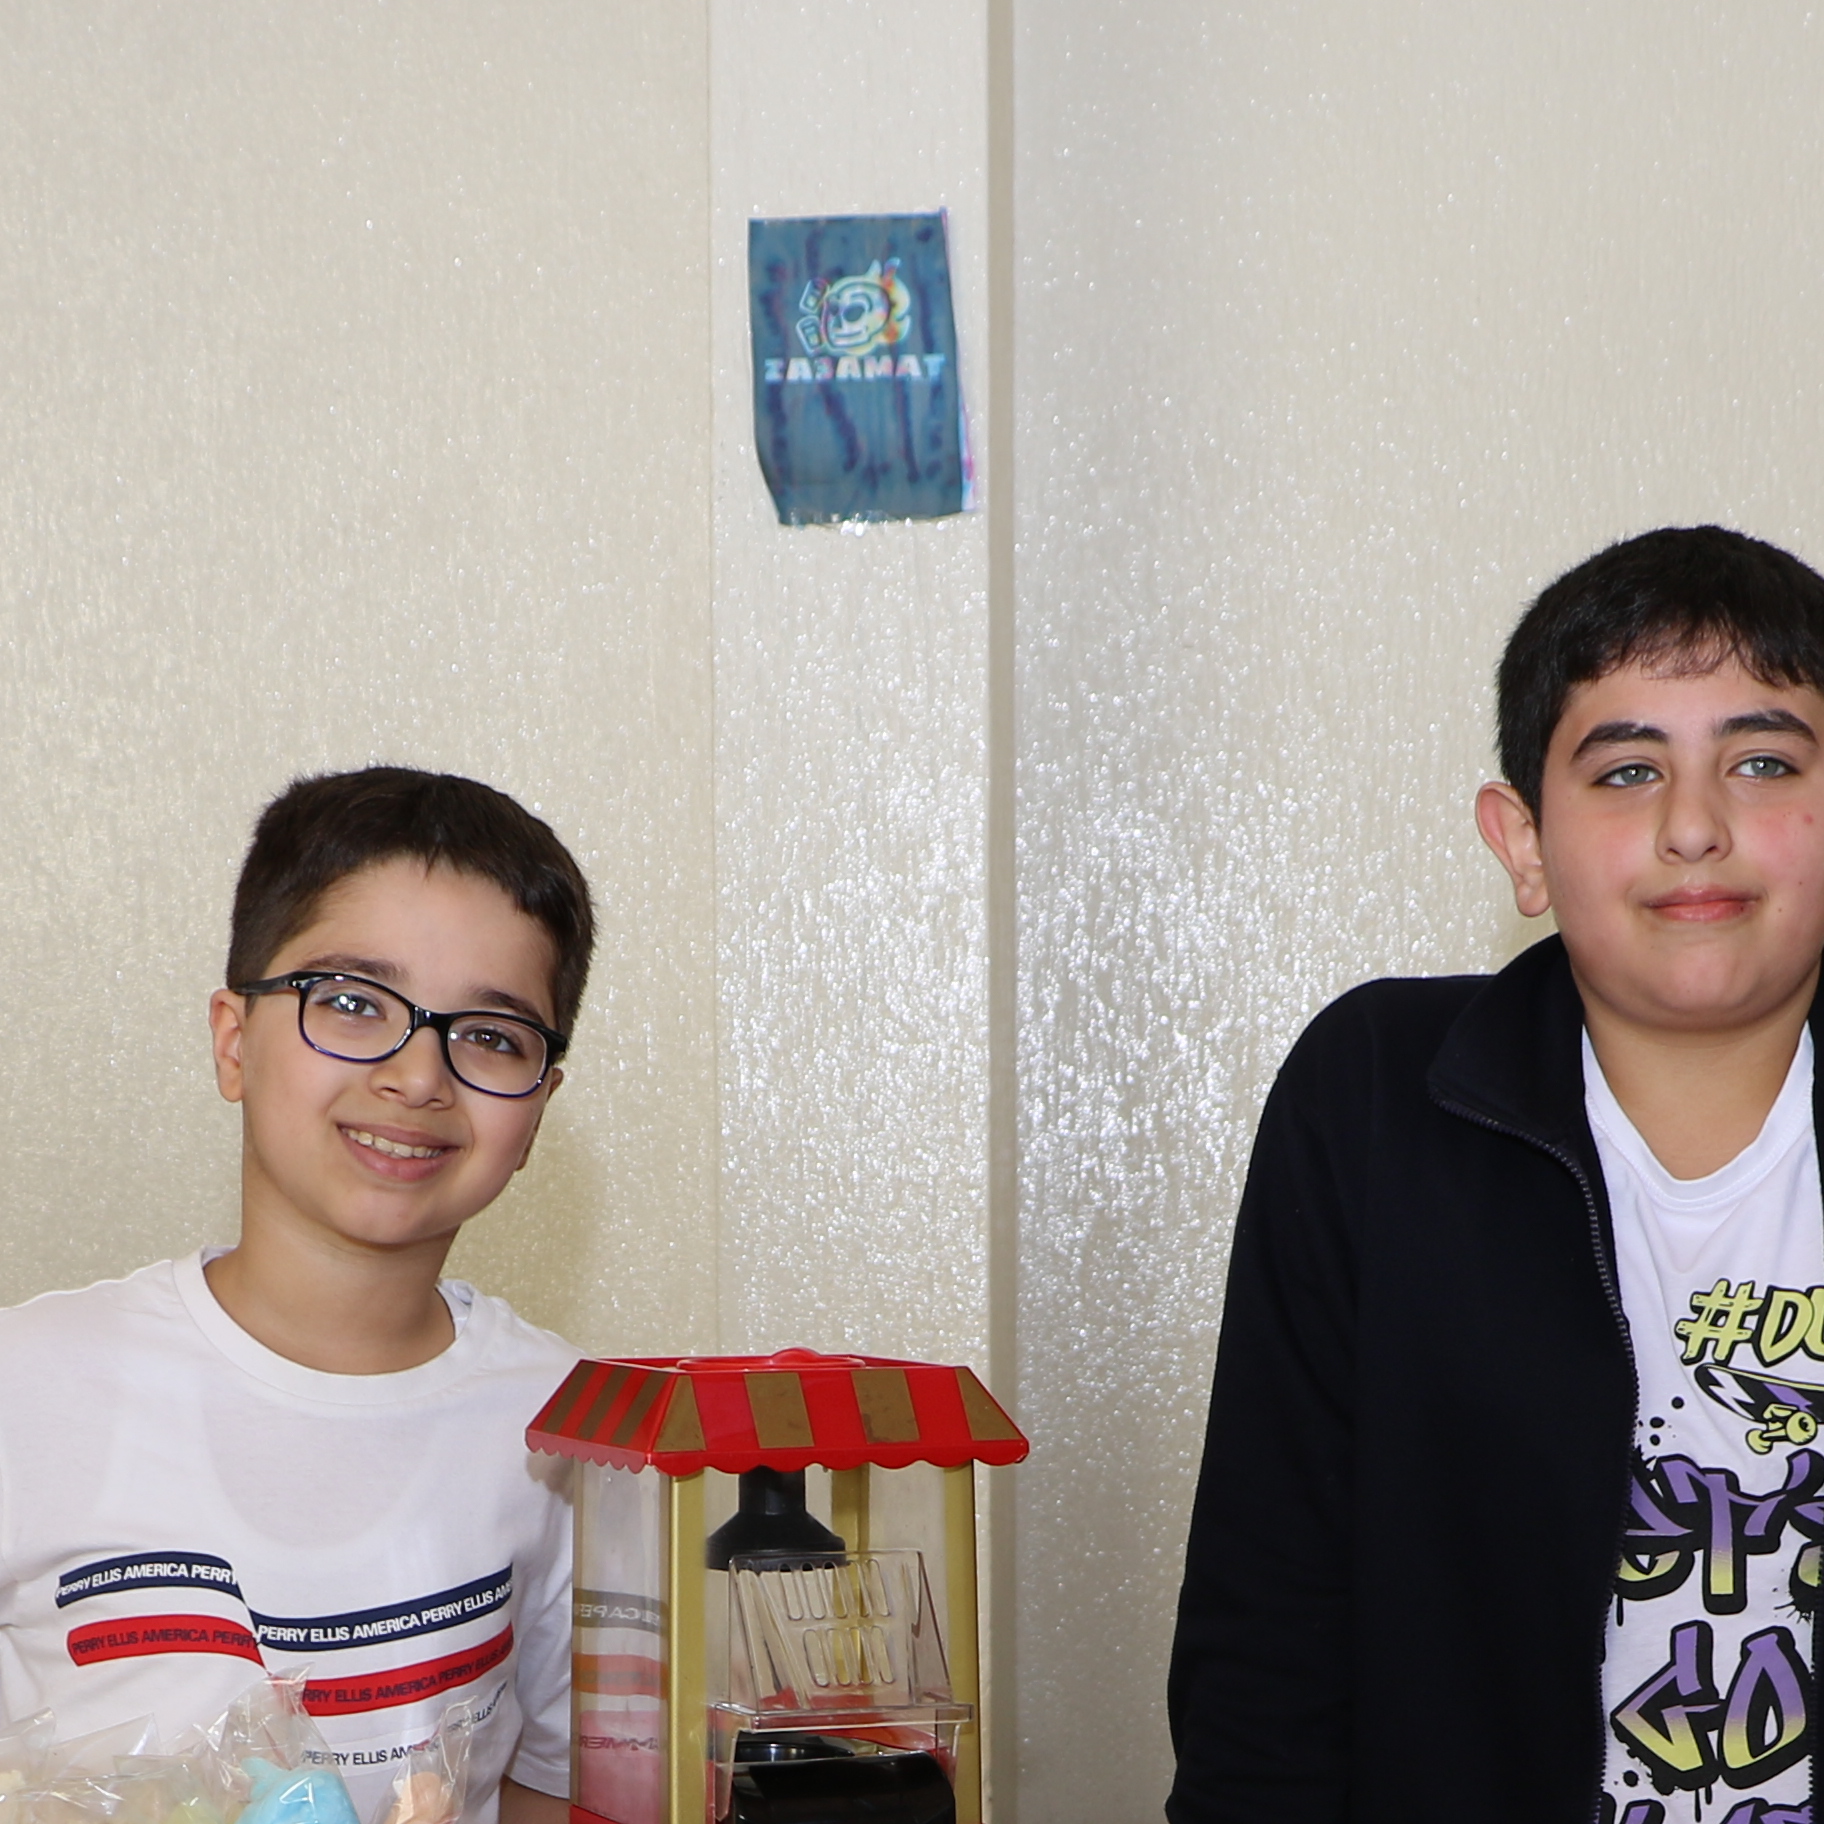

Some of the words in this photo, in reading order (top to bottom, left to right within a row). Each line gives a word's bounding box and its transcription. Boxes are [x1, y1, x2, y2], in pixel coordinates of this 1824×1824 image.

[55, 1576, 91, 1599] PERRY
[91, 1567, 122, 1588] ELLIS
[123, 1562, 188, 1580] AMERICA
[257, 1624, 308, 1643] PERRY
[309, 1626, 350, 1643] ELLIS
[352, 1613, 421, 1640] AMERICA
[421, 1601, 463, 1625] PERRY
[463, 1590, 494, 1613] ELLIS
[107, 1630, 139, 1647] ELLIS
[141, 1629, 209, 1645] AMERICA
[335, 1688, 373, 1702] ELLIS
[375, 1676, 437, 1701] AMERICA
[437, 1661, 475, 1684] PERRY
[352, 1749, 388, 1766] ELLIS
